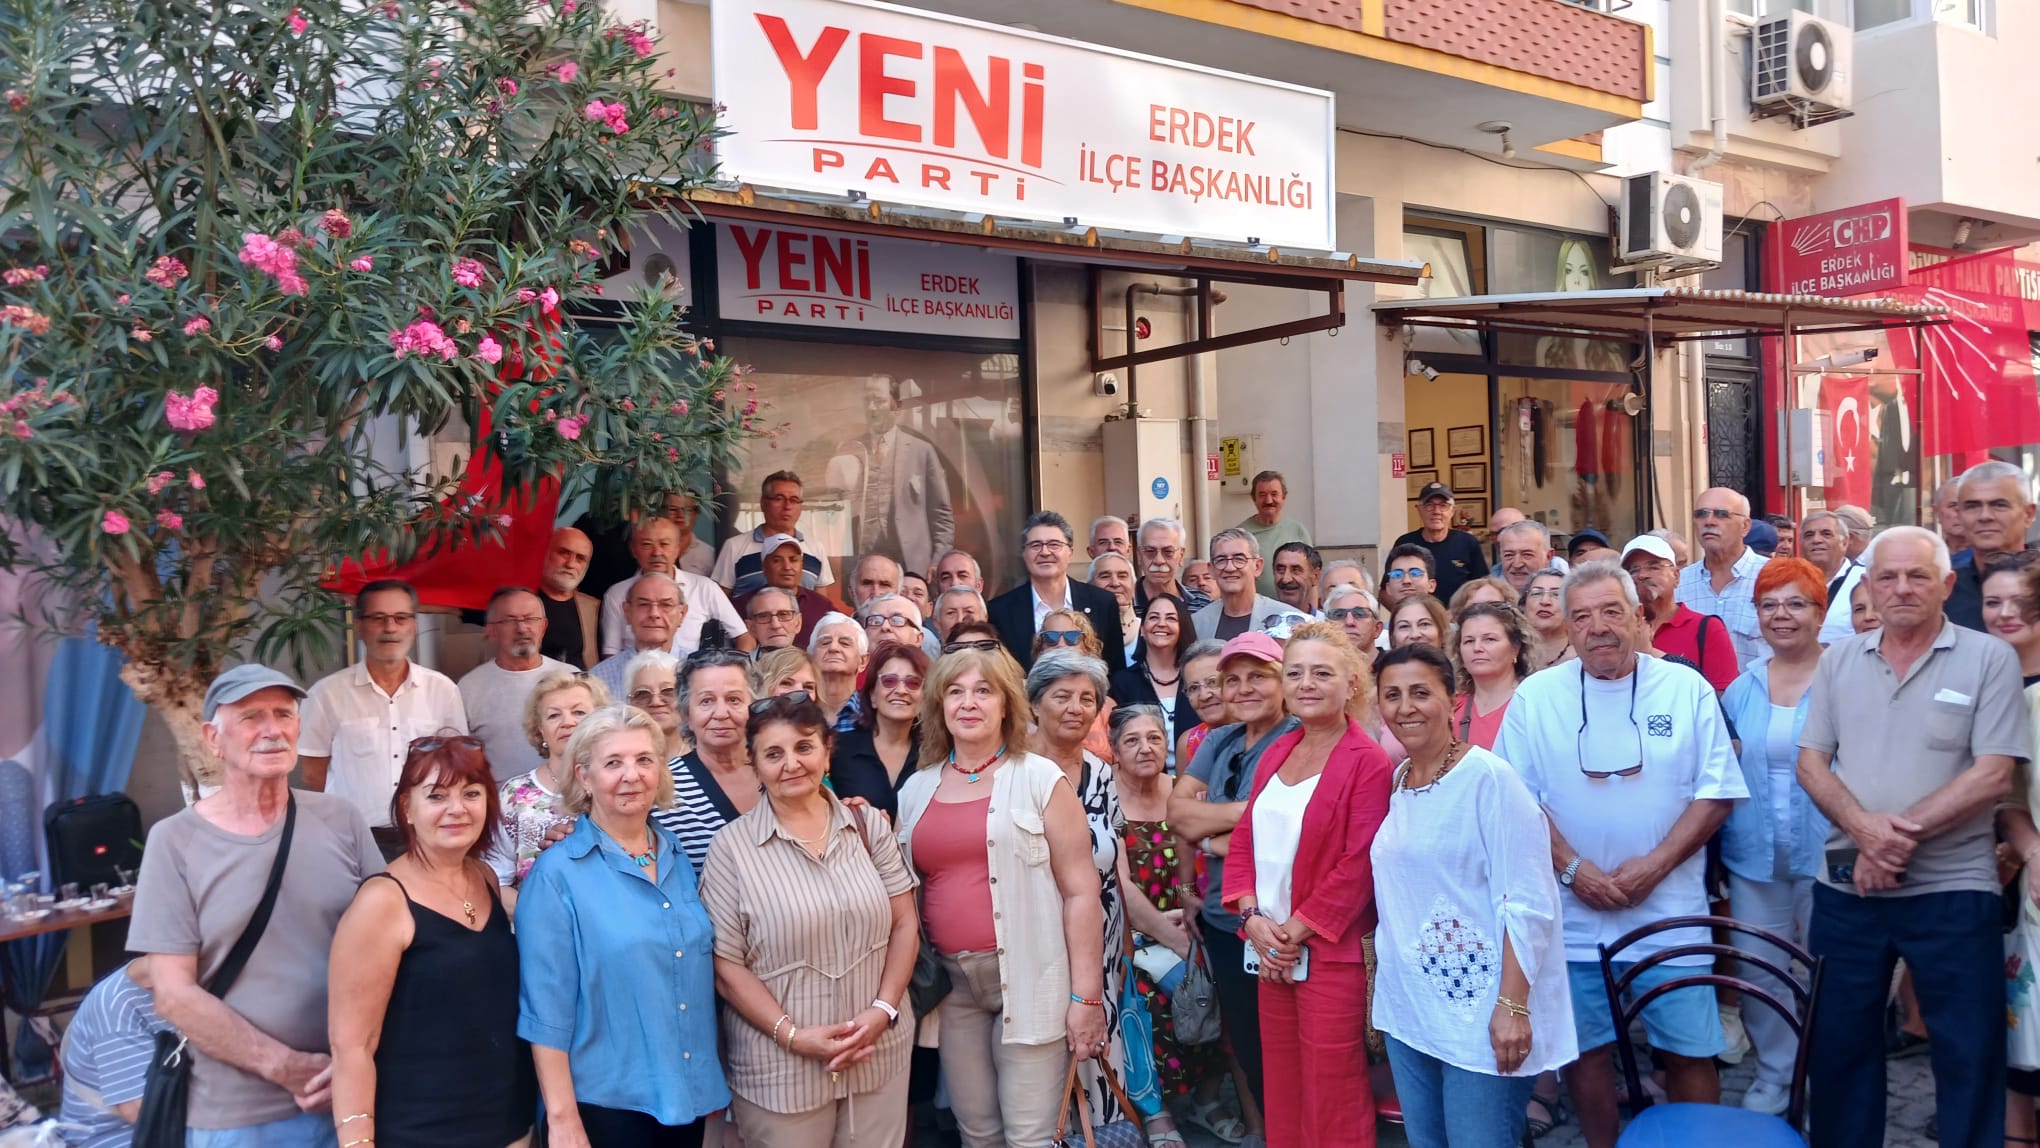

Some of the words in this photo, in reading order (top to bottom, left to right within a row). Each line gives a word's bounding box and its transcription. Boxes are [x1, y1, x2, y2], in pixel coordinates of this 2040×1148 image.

[1150, 104, 1255, 156] ERDEK
[1080, 142, 1141, 194] İLÇE
[1151, 160, 1312, 210] BAŞKANLIĞI
[1834, 213, 1890, 247] CHP
[1820, 263, 1894, 290] BAŞKANLIĞI
[1821, 254, 1862, 273] ERDEK
[921, 273, 980, 295] ERDEK
[886, 293, 919, 316] İLÇE
[924, 299, 1013, 320] BAŞKANLIĞI
